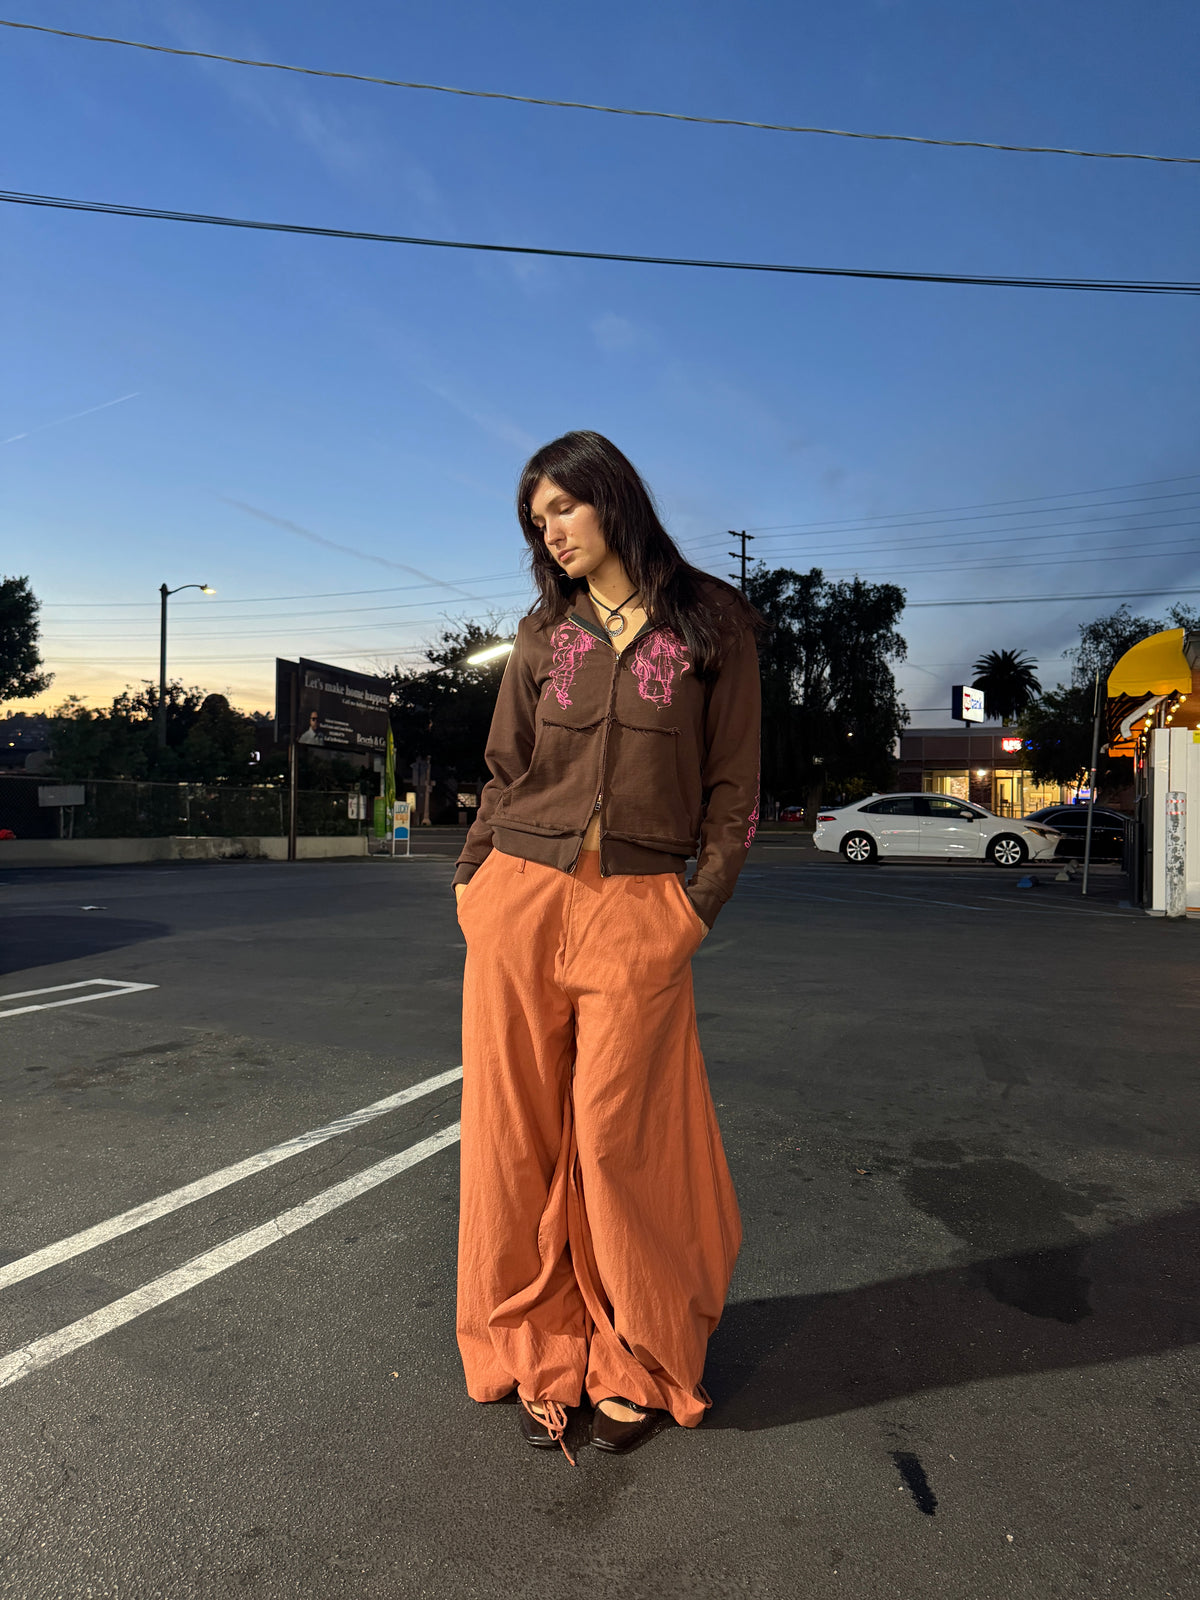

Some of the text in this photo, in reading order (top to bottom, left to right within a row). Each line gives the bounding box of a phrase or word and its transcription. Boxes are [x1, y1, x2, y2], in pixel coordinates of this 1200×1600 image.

[305, 674, 323, 691] Let's
[324, 682, 345, 695] make
[345, 684, 364, 700] home
